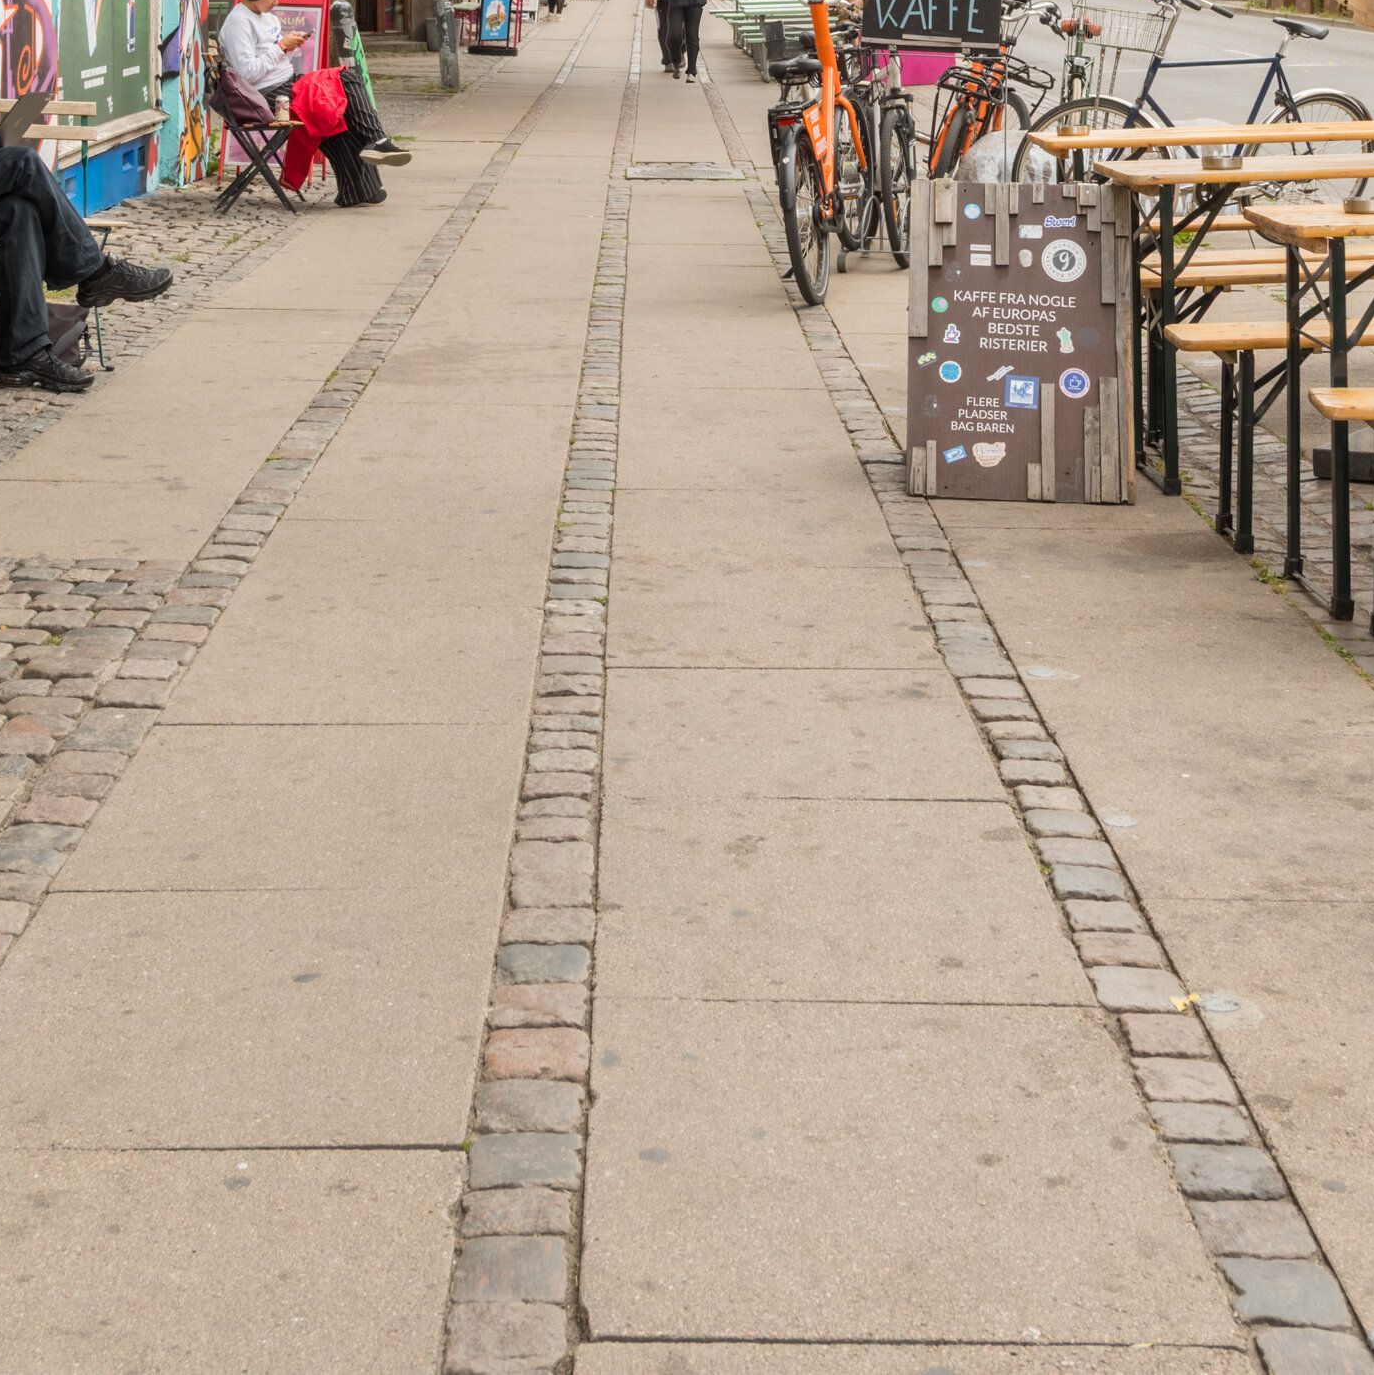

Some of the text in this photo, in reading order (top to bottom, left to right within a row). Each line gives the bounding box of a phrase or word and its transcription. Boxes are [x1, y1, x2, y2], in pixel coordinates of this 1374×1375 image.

[281, 16, 305, 26] NUM
[953, 289, 1076, 308] KAFFE FRA NOGLE
[972, 306, 1056, 322] AF EUROPAS
[988, 322, 1040, 337] BEDSTE
[979, 337, 1048, 353] RISTERIER
[966, 396, 1000, 408] FLERE
[958, 408, 1008, 421] PLADSER
[950, 420, 1015, 434] BAG BAREN
